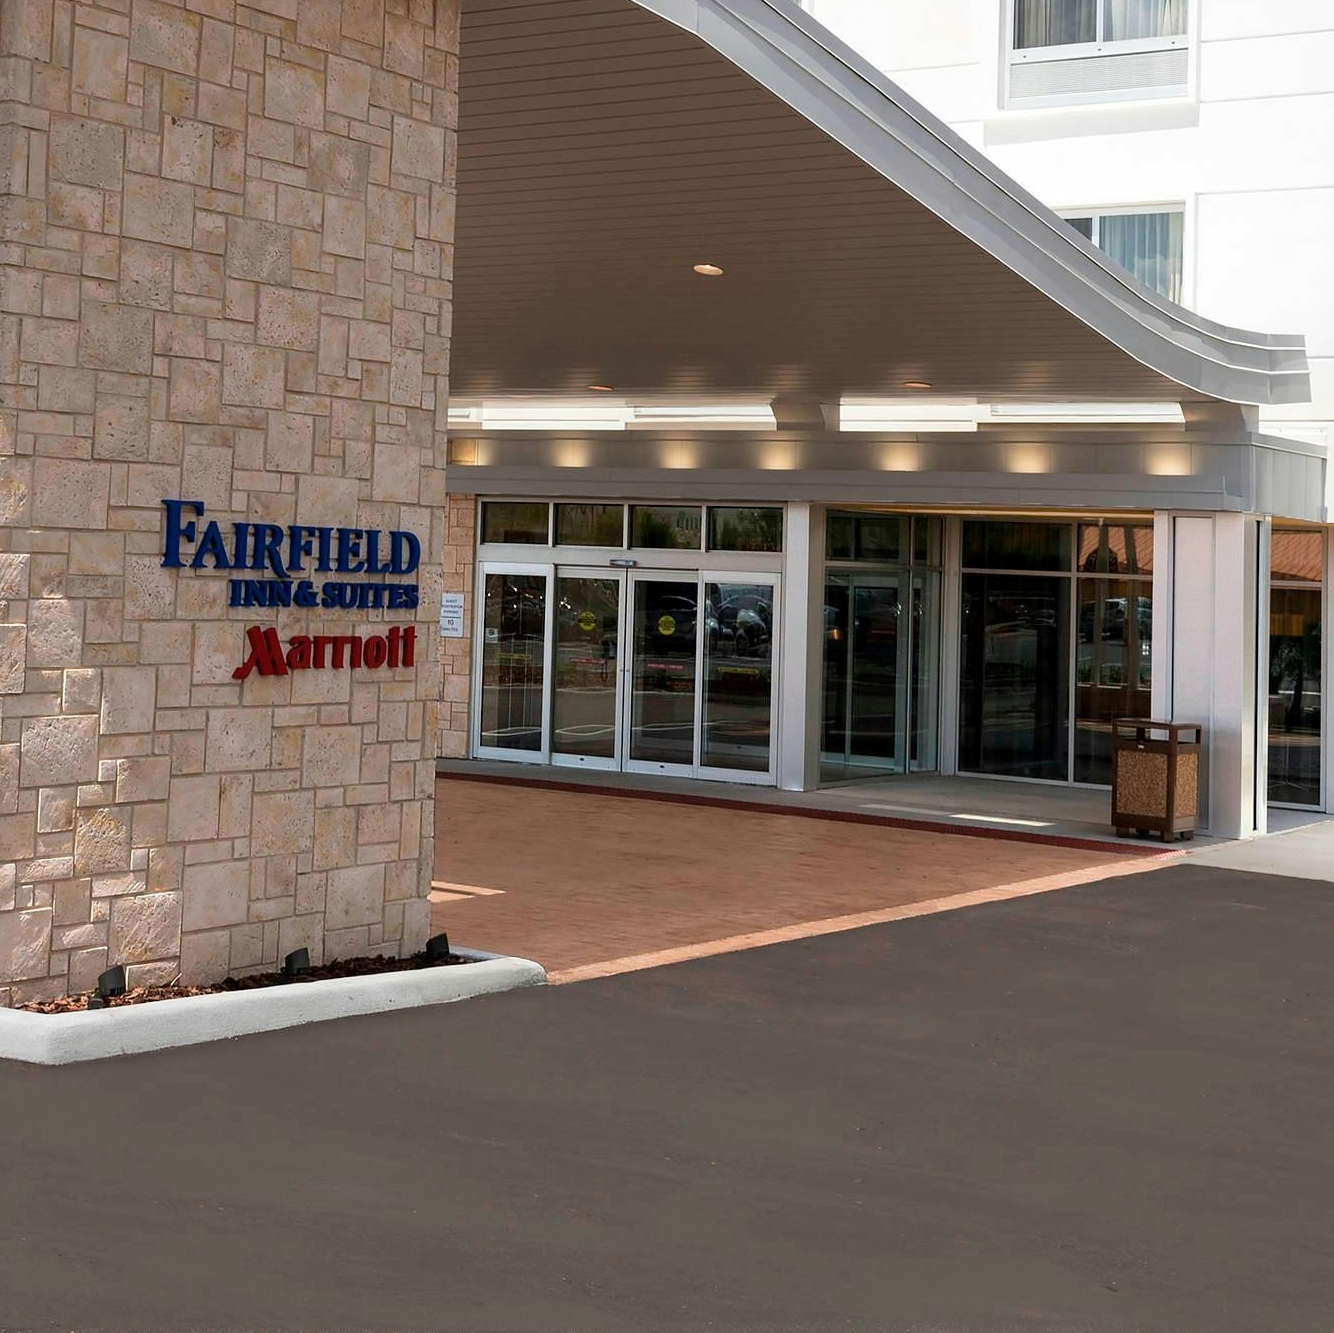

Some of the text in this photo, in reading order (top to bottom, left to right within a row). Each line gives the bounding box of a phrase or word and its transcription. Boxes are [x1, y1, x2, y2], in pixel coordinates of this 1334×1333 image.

[161, 499, 421, 577] FAIRFIELD
[229, 579, 419, 609] INN & SUITES
[232, 625, 417, 680] Marriott
